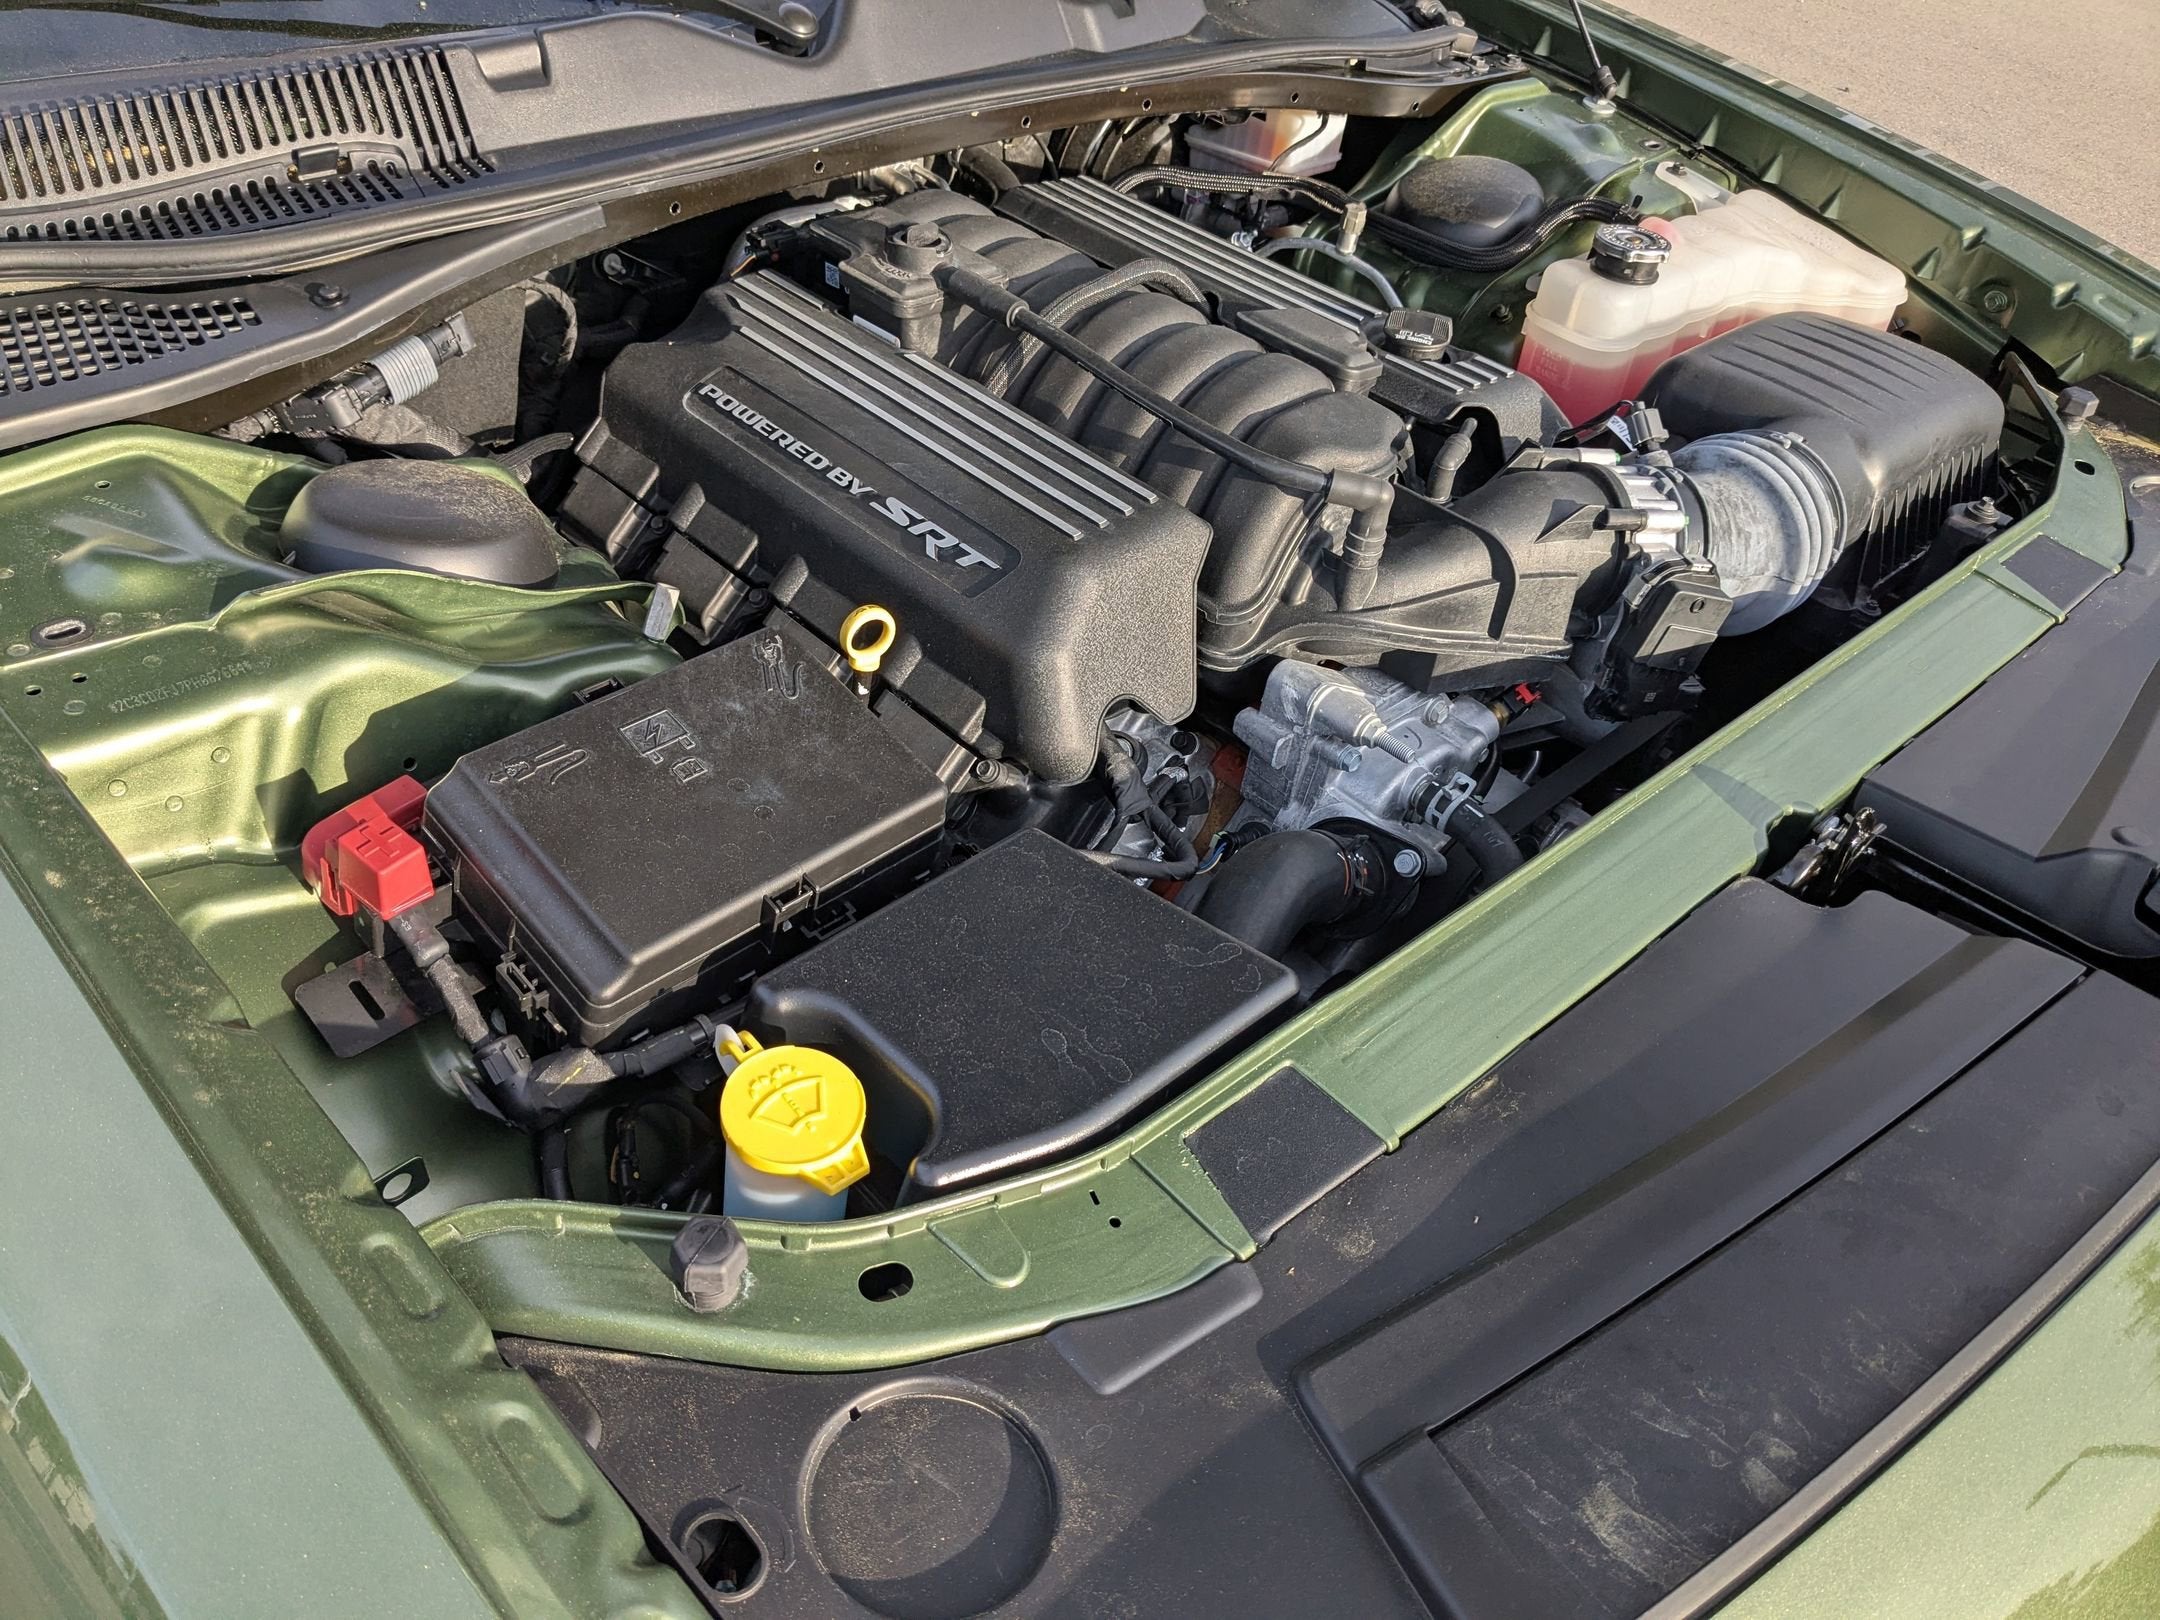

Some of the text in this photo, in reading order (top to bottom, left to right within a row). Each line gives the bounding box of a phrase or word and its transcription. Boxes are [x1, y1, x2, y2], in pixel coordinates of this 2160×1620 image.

[698, 383, 1002, 569] POWERED BY SRT
